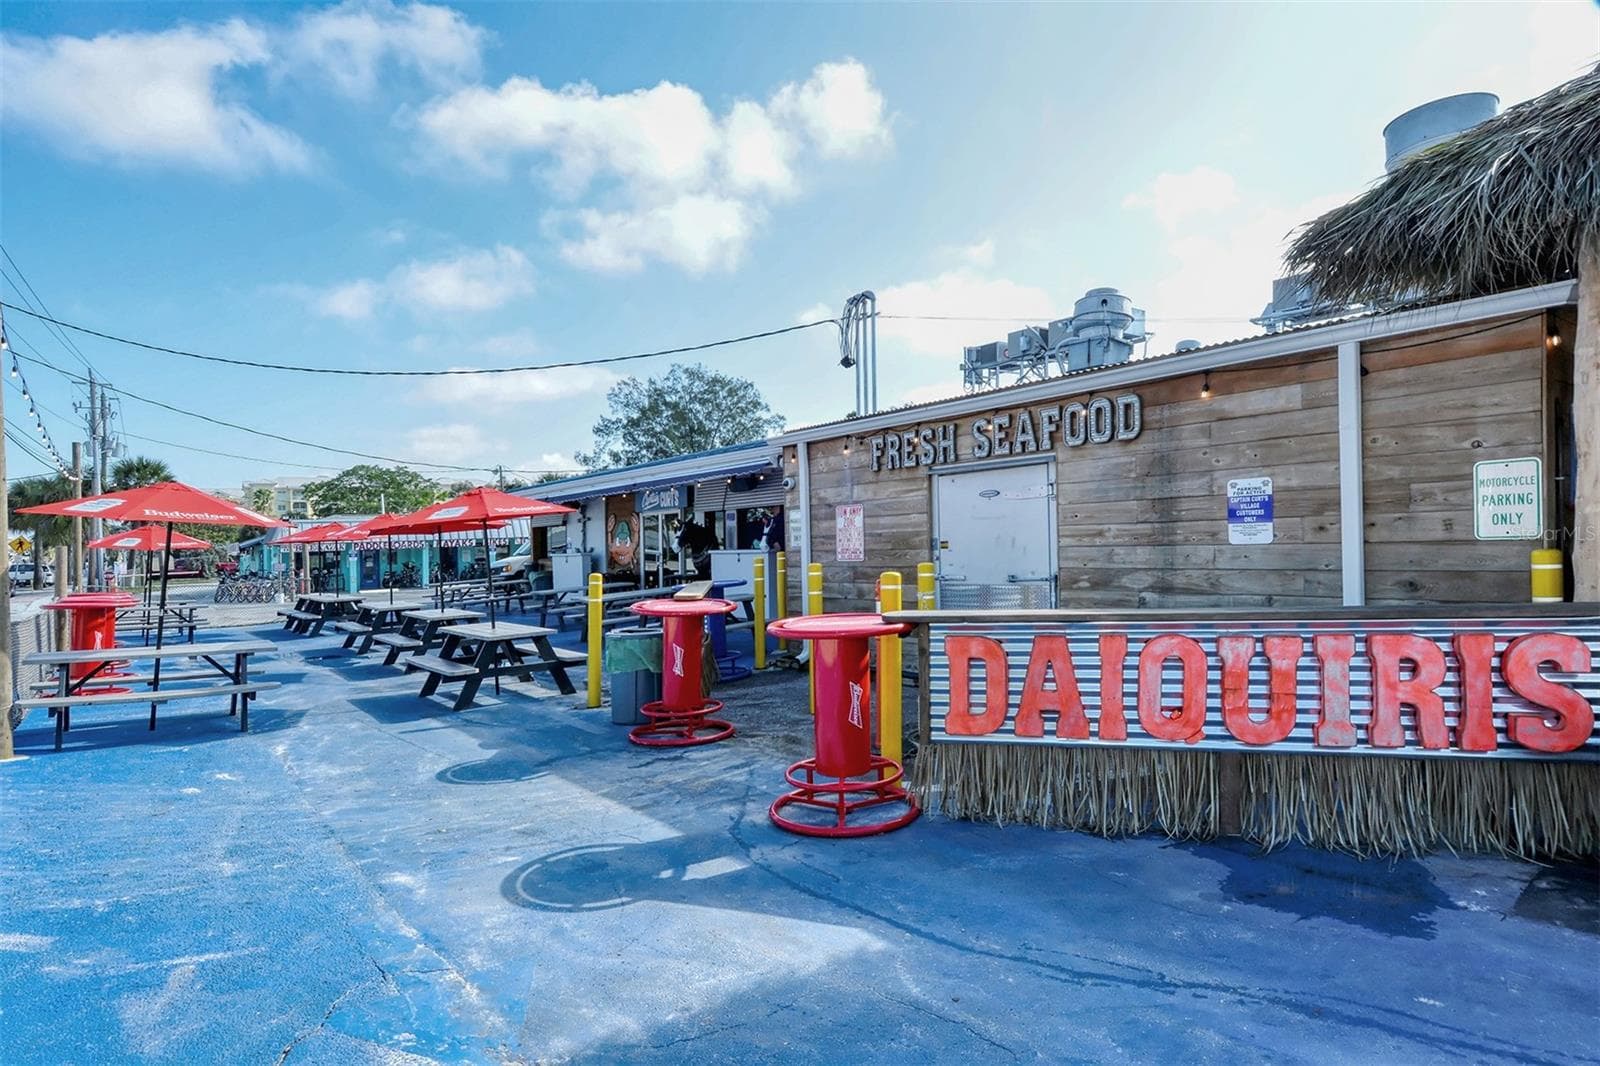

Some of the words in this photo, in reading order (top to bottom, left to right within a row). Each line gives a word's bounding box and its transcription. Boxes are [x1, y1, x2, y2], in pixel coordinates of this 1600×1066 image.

[868, 422, 957, 472] FRESH
[971, 392, 1143, 459] SEAFOOD
[1479, 476, 1535, 488] MOTORCYCLE
[1482, 493, 1533, 507] PARKING
[143, 508, 238, 521] Budweiser
[1491, 512, 1524, 526] ONLY
[943, 631, 1594, 754] DAIQUIRIS
